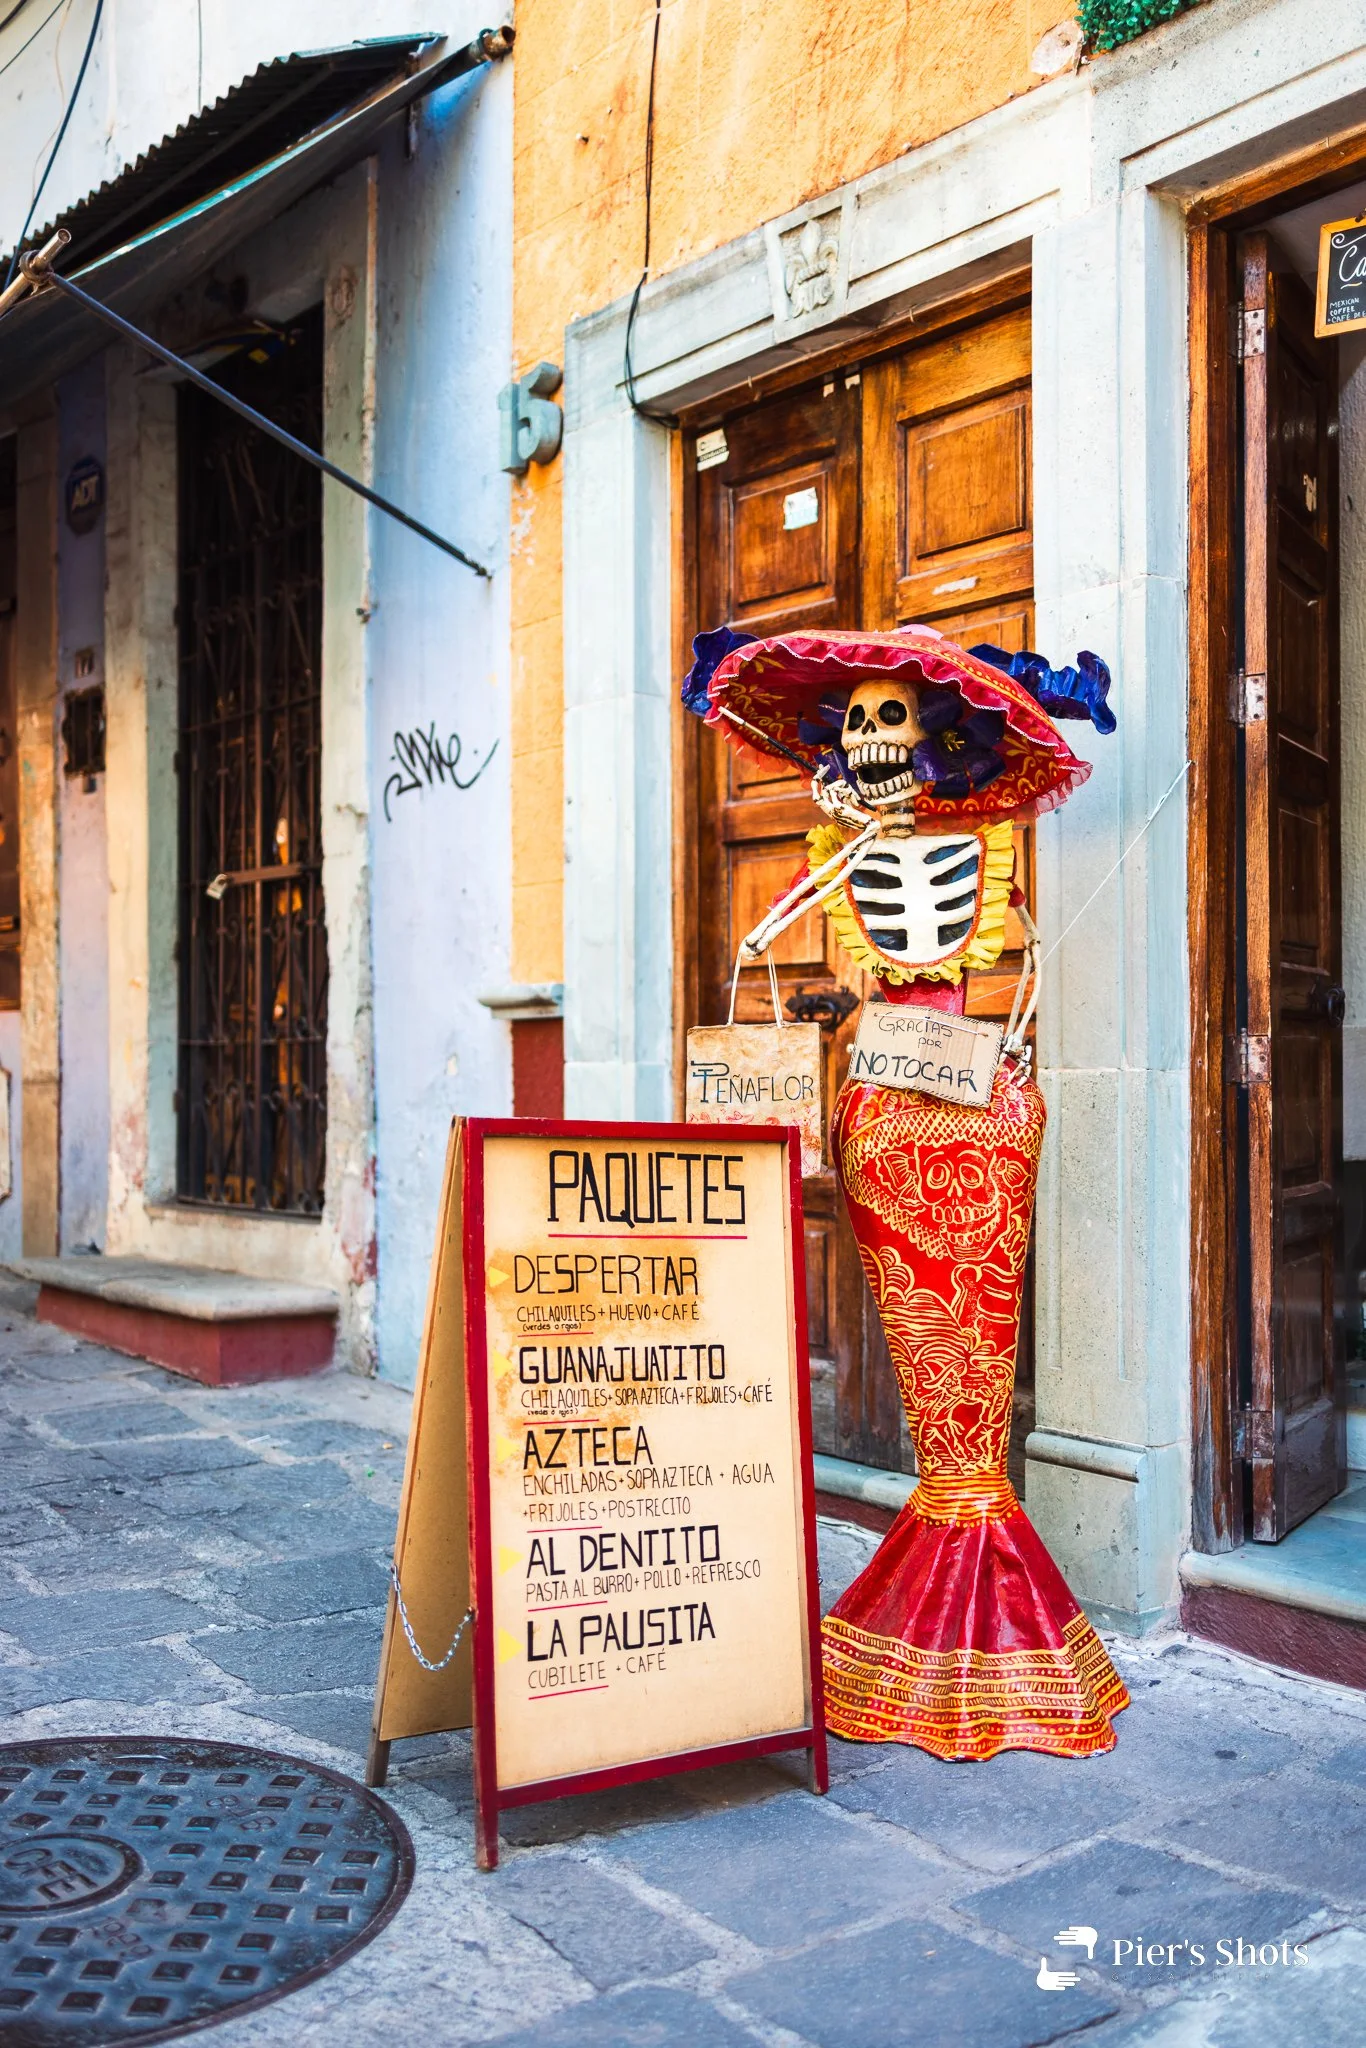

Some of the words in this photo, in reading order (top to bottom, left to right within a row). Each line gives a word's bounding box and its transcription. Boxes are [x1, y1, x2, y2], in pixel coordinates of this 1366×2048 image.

[1330, 298, 1359, 309] MEXICAN
[1330, 306, 1355, 316] COFFEE
[71, 475, 99, 513] ADT
[690, 1060, 814, 1104] PEÑAFLOR
[547, 1150, 746, 1229] PAQUETES
[514, 1255, 699, 1296] DESPERTAR
[516, 1304, 596, 1322] CHILAQUILES
[609, 1304, 651, 1321] HUEVO
[662, 1300, 700, 1321] CAFÉ
[519, 1344, 726, 1384] GUANAJUATITO
[520, 1388, 607, 1408] CHILAQUILES
[523, 1426, 654, 1470] AZTECA
[523, 1470, 617, 1496] ENCHILADAS
[732, 1462, 775, 1485] AGUA
[527, 1537, 566, 1578] AL
[579, 1525, 721, 1572] DENTITO
[526, 1580, 569, 1603] PASTA
[573, 1578, 589, 1598] AL
[644, 1568, 682, 1590] POLLO
[527, 1619, 568, 1662] LA
[579, 1602, 716, 1655] PAUSITA
[528, 1660, 607, 1689] CUBILETE
[626, 1649, 667, 1674] CAFÉ
